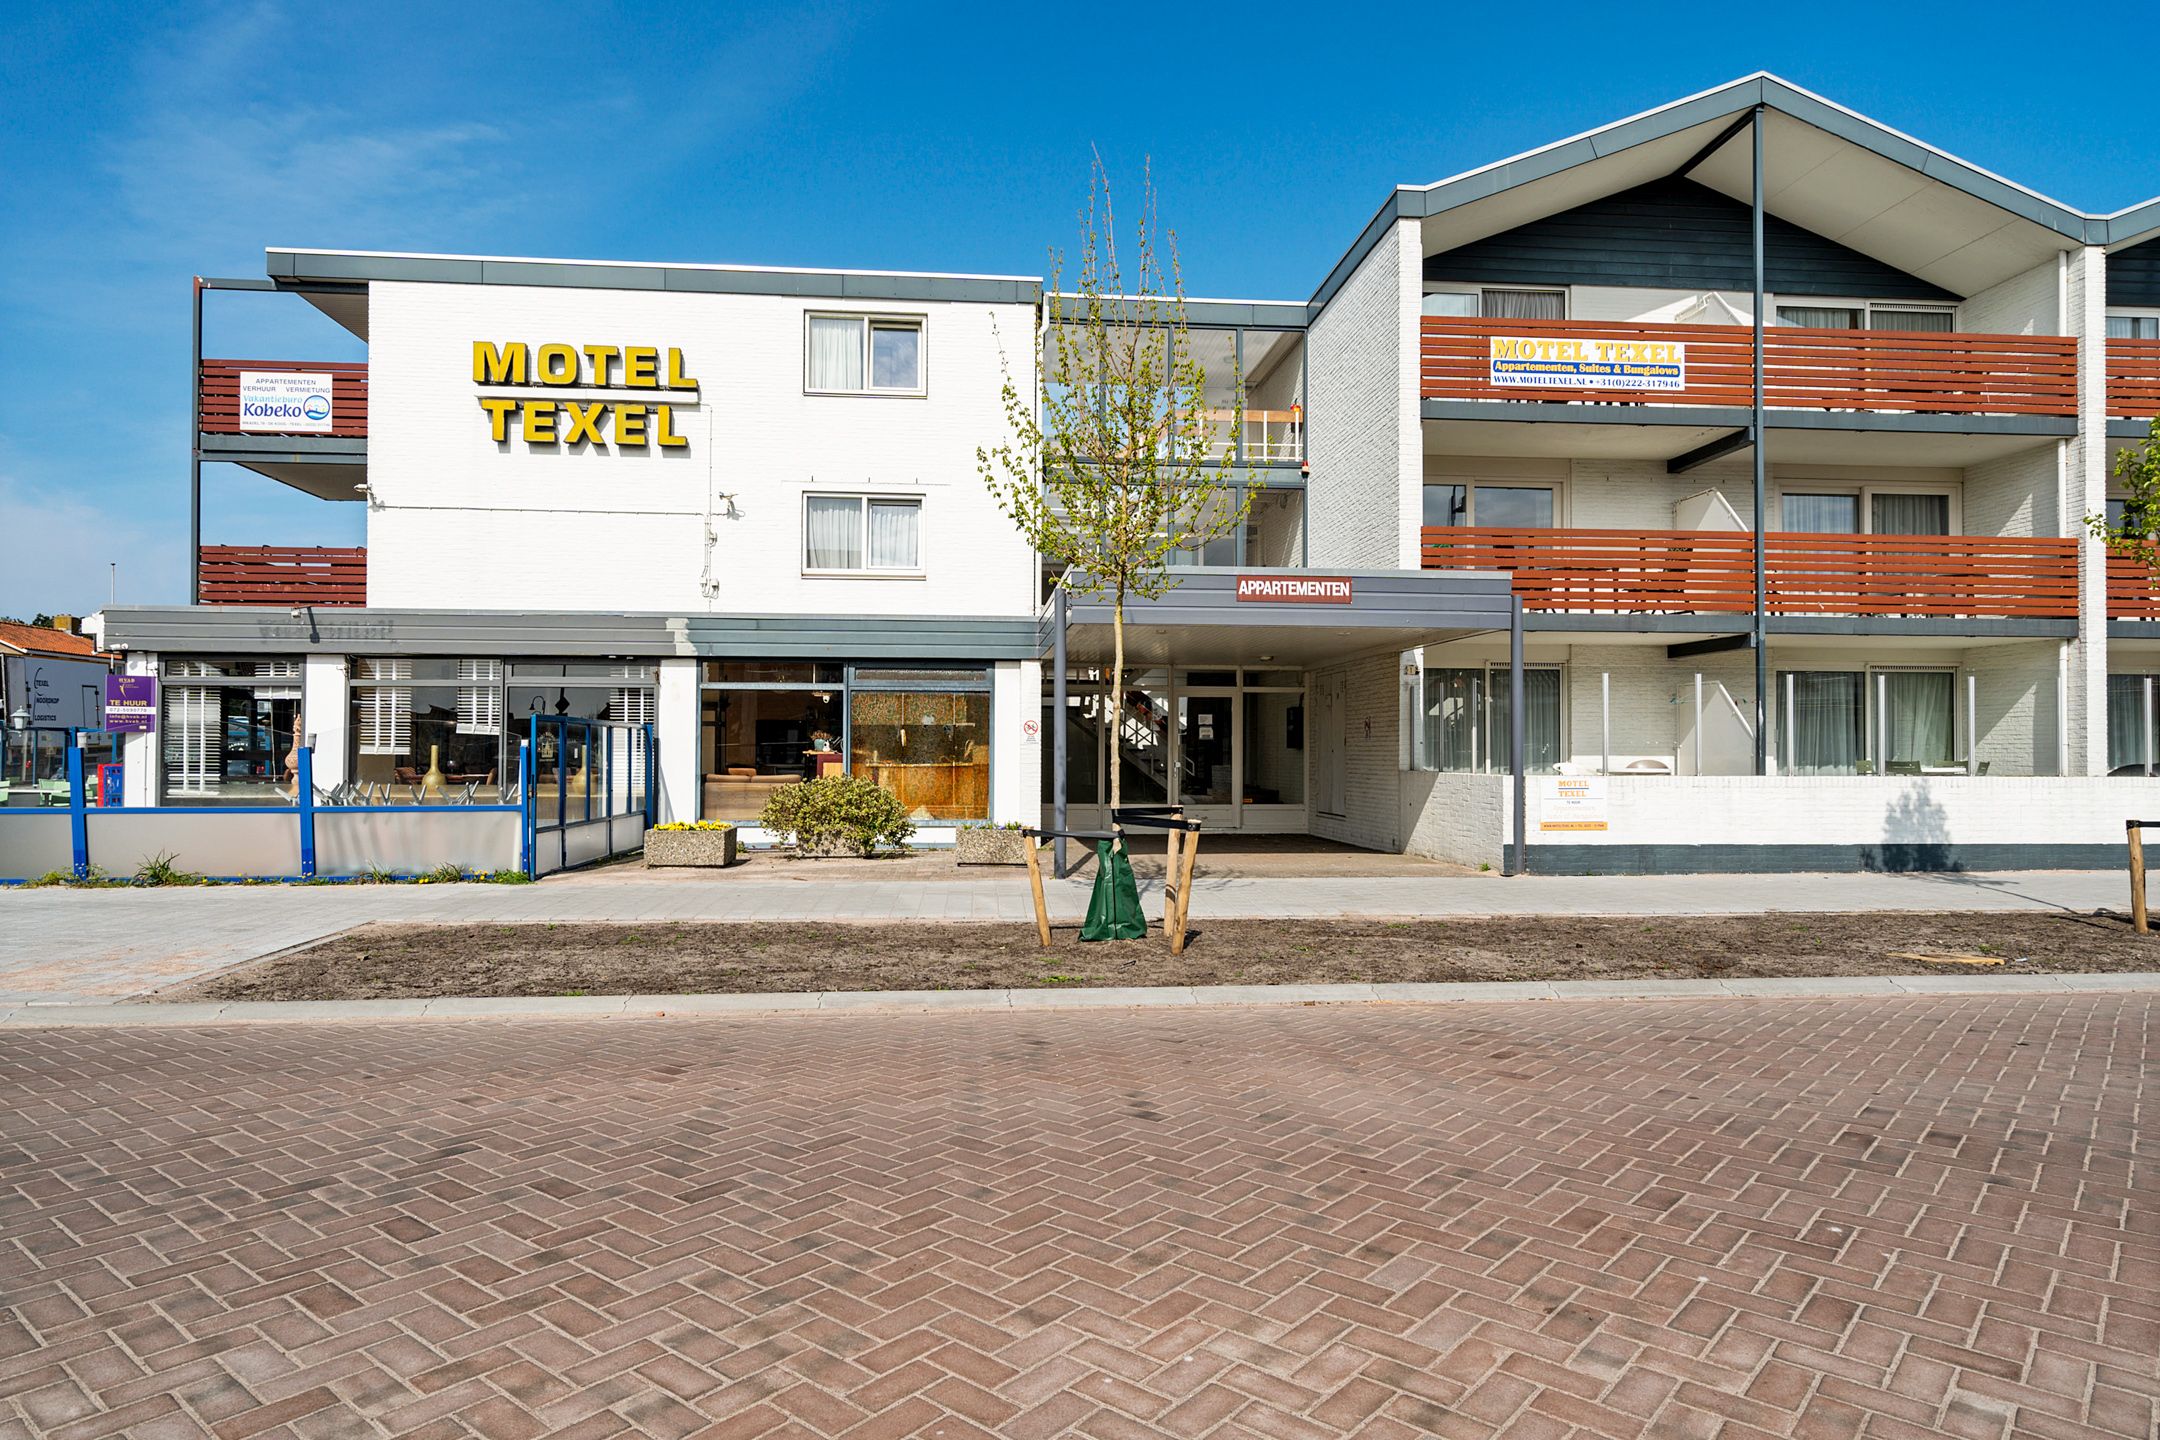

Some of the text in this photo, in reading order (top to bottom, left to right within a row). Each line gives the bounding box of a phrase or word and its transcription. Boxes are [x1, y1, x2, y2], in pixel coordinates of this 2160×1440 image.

[1493, 338, 1681, 364] MOTEL TEXEL
[473, 341, 700, 388] MOTEL
[1495, 361, 1679, 376] Appartementen, Suites & Bungalows
[256, 378, 316, 386] APPARTEMENTEN
[1493, 375, 1587, 386] WWW.MOTELTEXEL.NL
[285, 386, 331, 394] VERMIETUNG
[243, 403, 302, 418] Kobeko
[481, 399, 688, 446] TEXEL
[1238, 580, 1350, 597] APPARTEMENTEN
